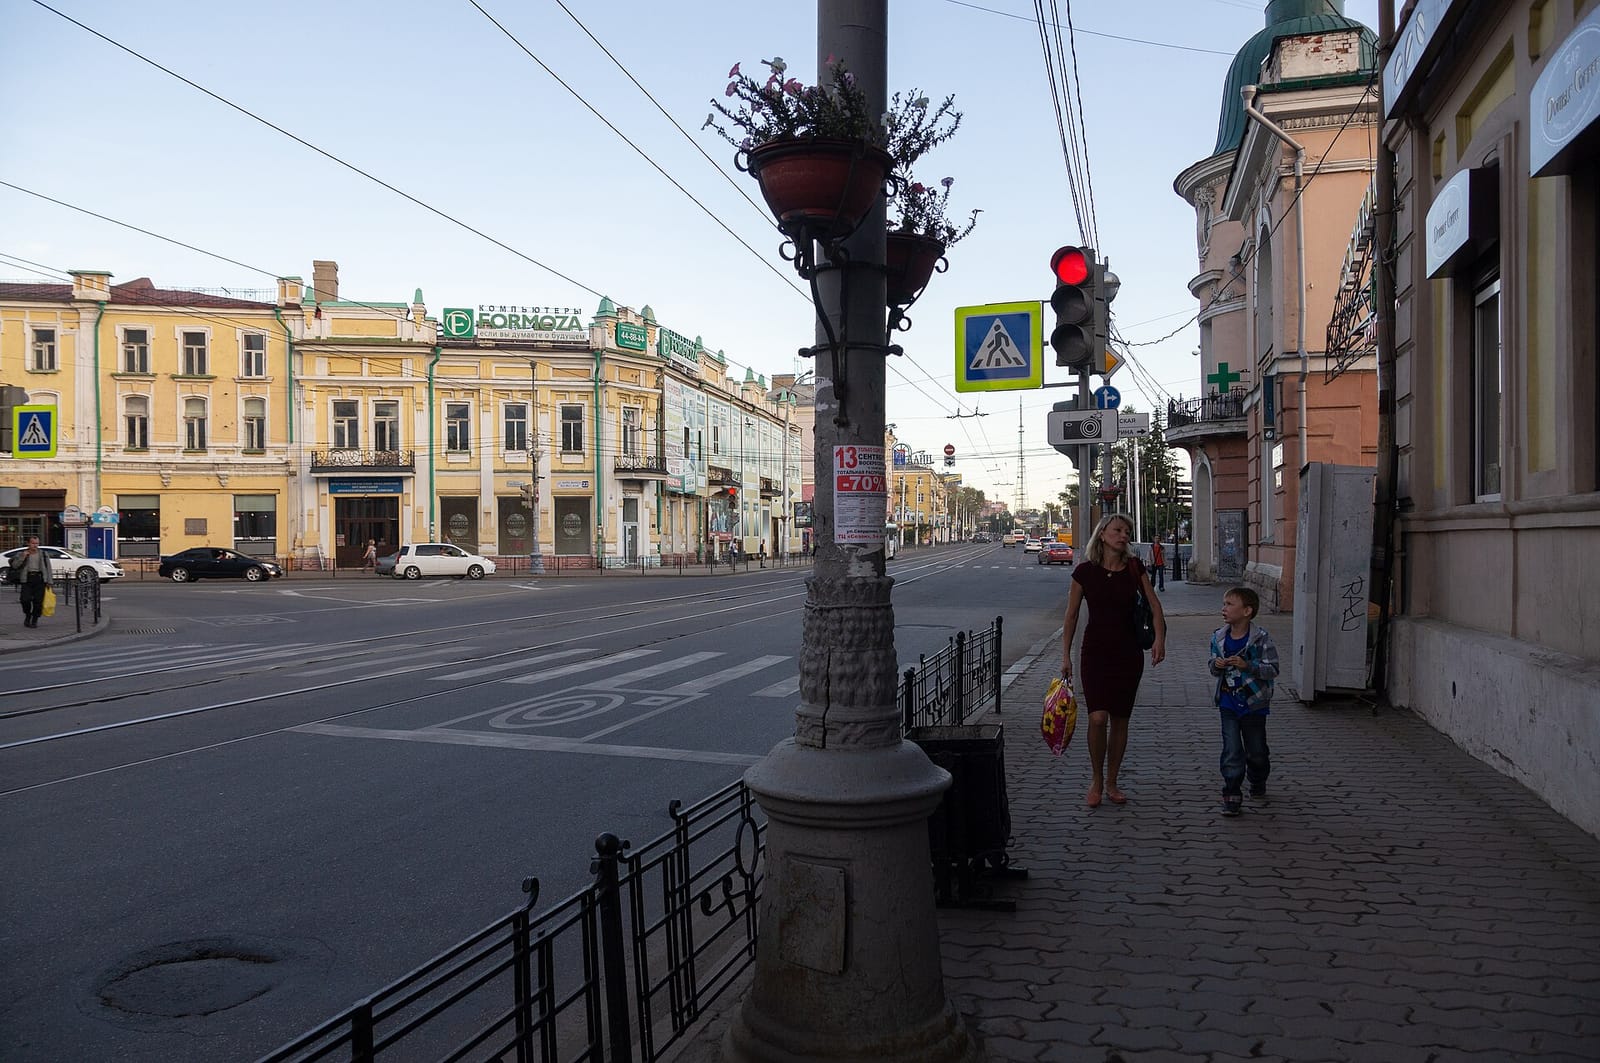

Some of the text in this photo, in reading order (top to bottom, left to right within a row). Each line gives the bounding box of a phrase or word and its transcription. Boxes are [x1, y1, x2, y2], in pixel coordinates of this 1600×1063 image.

[478, 305, 582, 315] КОМПЬЮТЕРЫ
[478, 313, 584, 332] FORMOZA
[511, 331, 543, 340] думаете
[551, 331, 585, 341] будущем
[836, 446, 858, 469] 13
